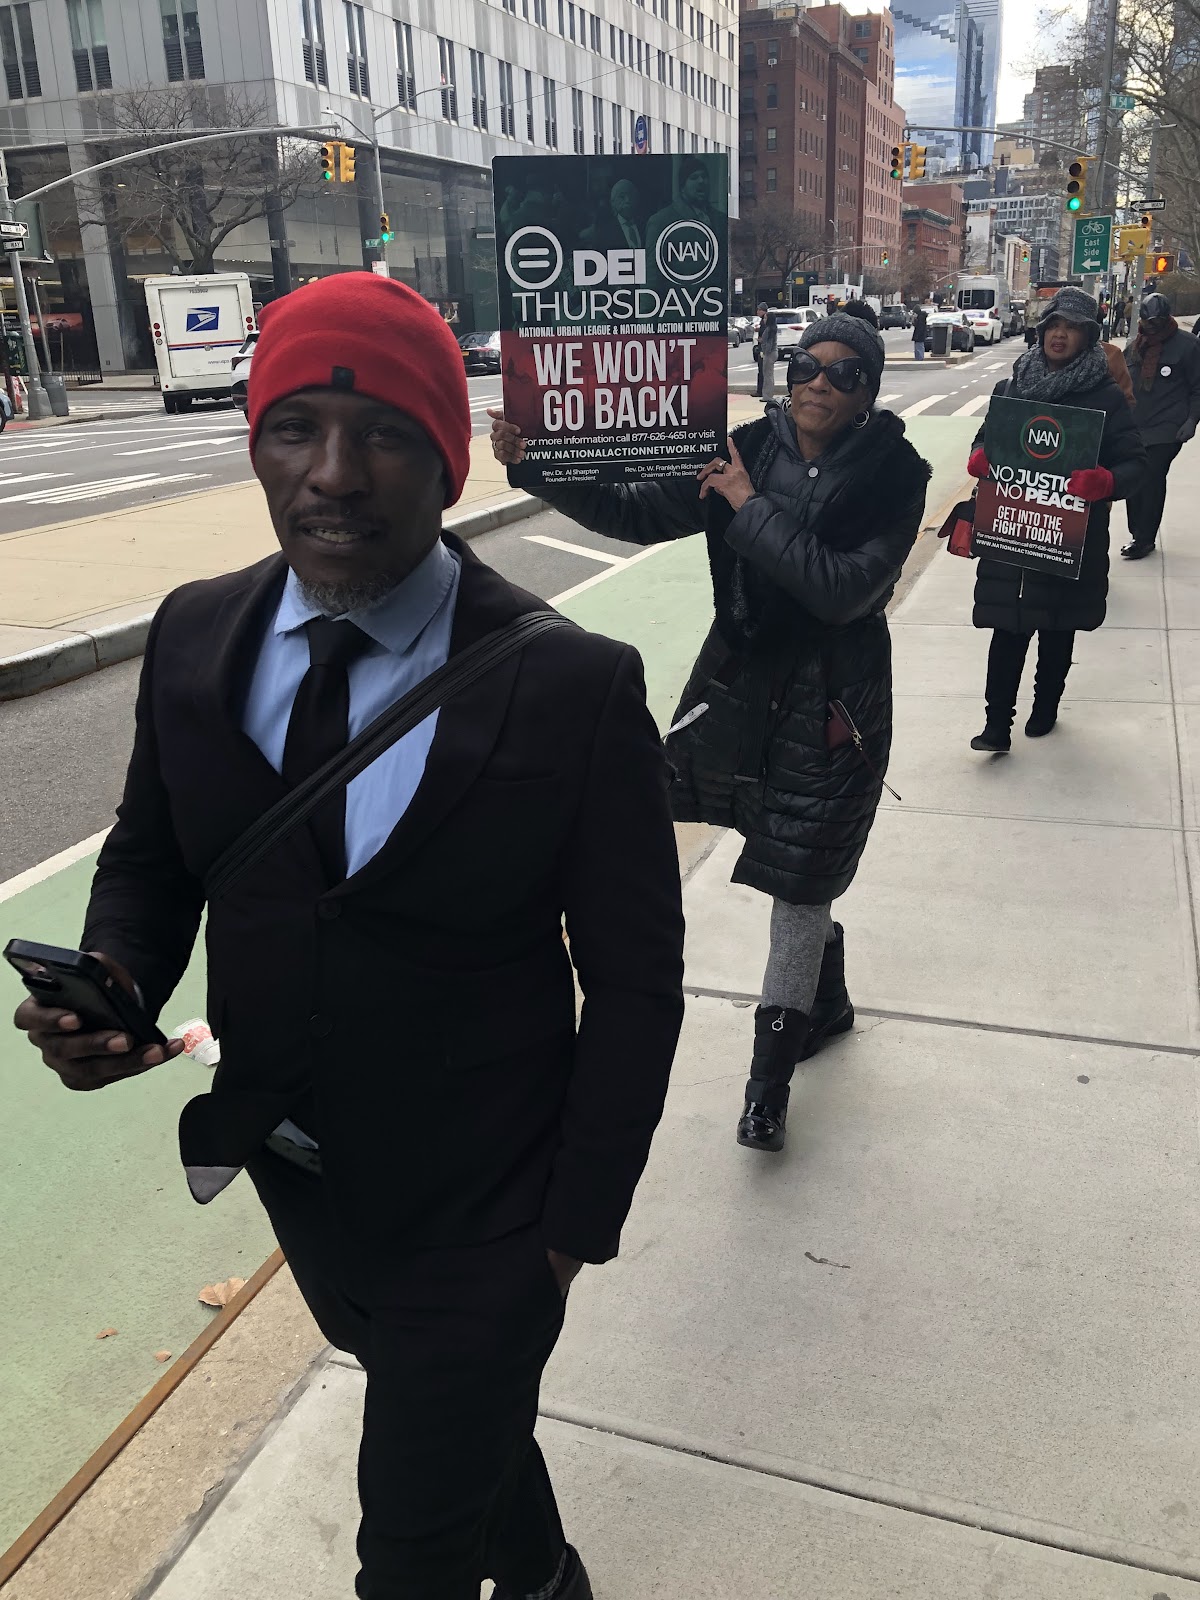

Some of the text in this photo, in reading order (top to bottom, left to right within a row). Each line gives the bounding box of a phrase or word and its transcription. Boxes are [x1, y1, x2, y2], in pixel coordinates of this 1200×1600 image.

[1119, 97, 1127, 108] 54
[667, 241, 709, 262] NAN
[1084, 238, 1100, 246] East
[1084, 247, 1100, 256] Side
[573, 249, 646, 286] DEI
[512, 287, 723, 321] THURSDAYS
[812, 293, 835, 304] FedE
[519, 321, 720, 338] NATIONAL URBAN LEAGUE & NATIONAL ACTION NETWORK
[533, 338, 697, 386] WE WON'T
[543, 385, 689, 432] GO BACK!
[523, 437, 537, 446] For
[538, 437, 562, 446] more
[564, 434, 615, 445] information
[616, 433, 630, 442] call
[632, 431, 687, 442] 877-626-4651
[698, 429, 716, 439] visit
[1027, 428, 1060, 448] NAN
[987, 463, 1014, 482] NO
[996, 481, 1086, 513] NO PEACE
[997, 505, 1063, 532] GET INTO THE
[992, 518, 1064, 547] FIGHT TODAY!
[975, 539, 1075, 565] WWW.NATIONALACTIONNETWORK.NET
